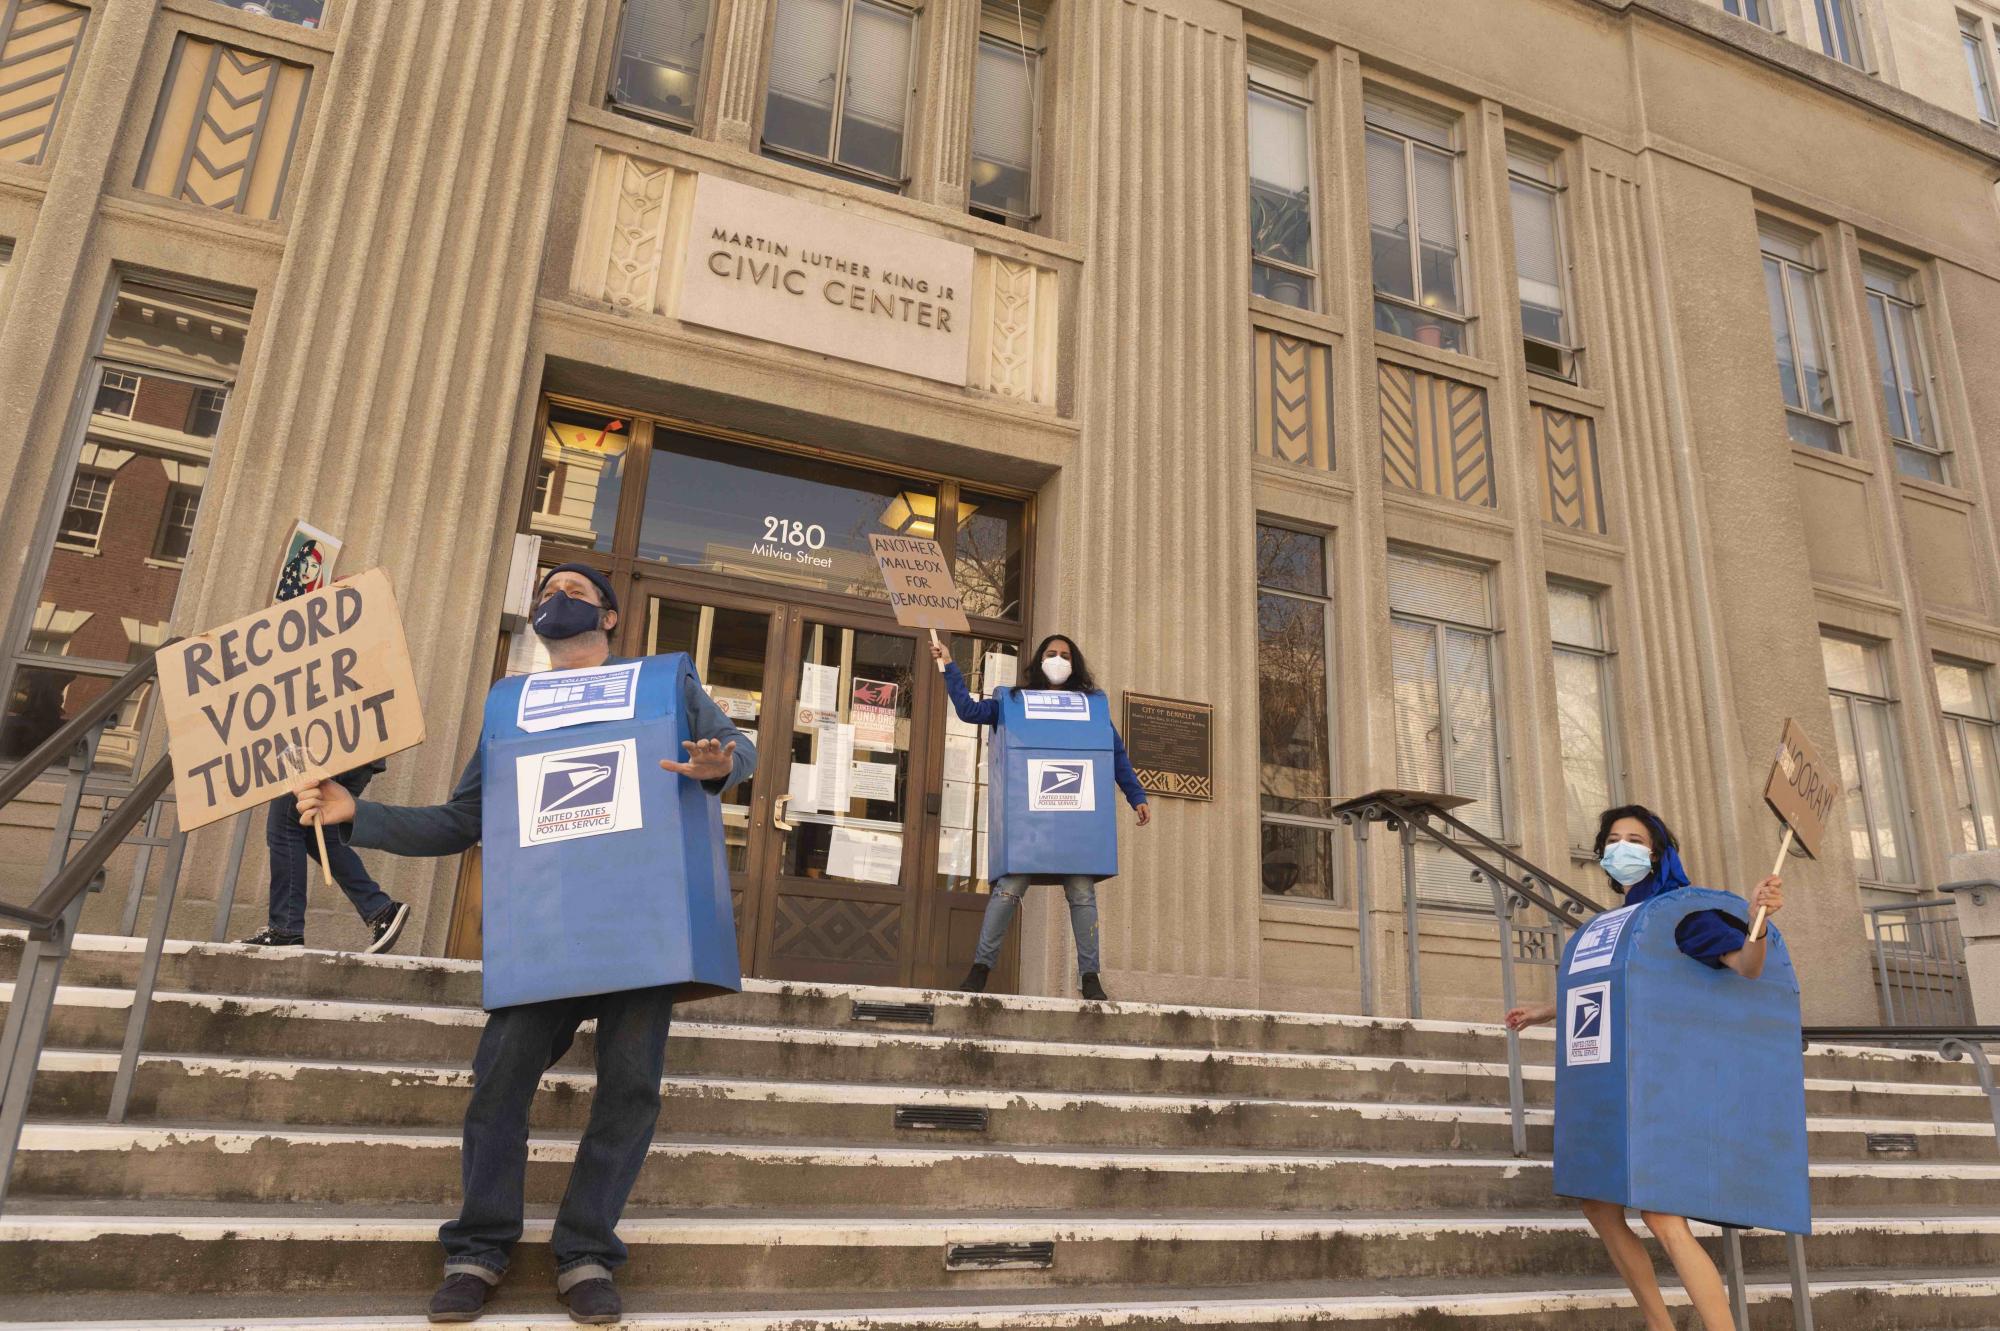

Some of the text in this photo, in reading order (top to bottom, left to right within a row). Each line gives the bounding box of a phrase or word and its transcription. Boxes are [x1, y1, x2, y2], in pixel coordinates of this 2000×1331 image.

[712, 227, 955, 301] MARTIN LUTHER KING JR
[708, 250, 952, 333] CIVIC CENTER
[762, 516, 826, 550] 2180
[751, 542, 833, 568] Milvia Street
[875, 538, 940, 557] ANOTHER
[880, 557, 943, 573] MAILBOX
[905, 575, 932, 589] FOR
[890, 592, 961, 610] DEMOCRACY
[183, 587, 363, 697] RECORD
[201, 647, 365, 746] VOTER
[188, 689, 395, 807] TURNOUT
[536, 816, 610, 836] POSTAL SERVICE
[537, 806, 606, 825] UNITED STATES
